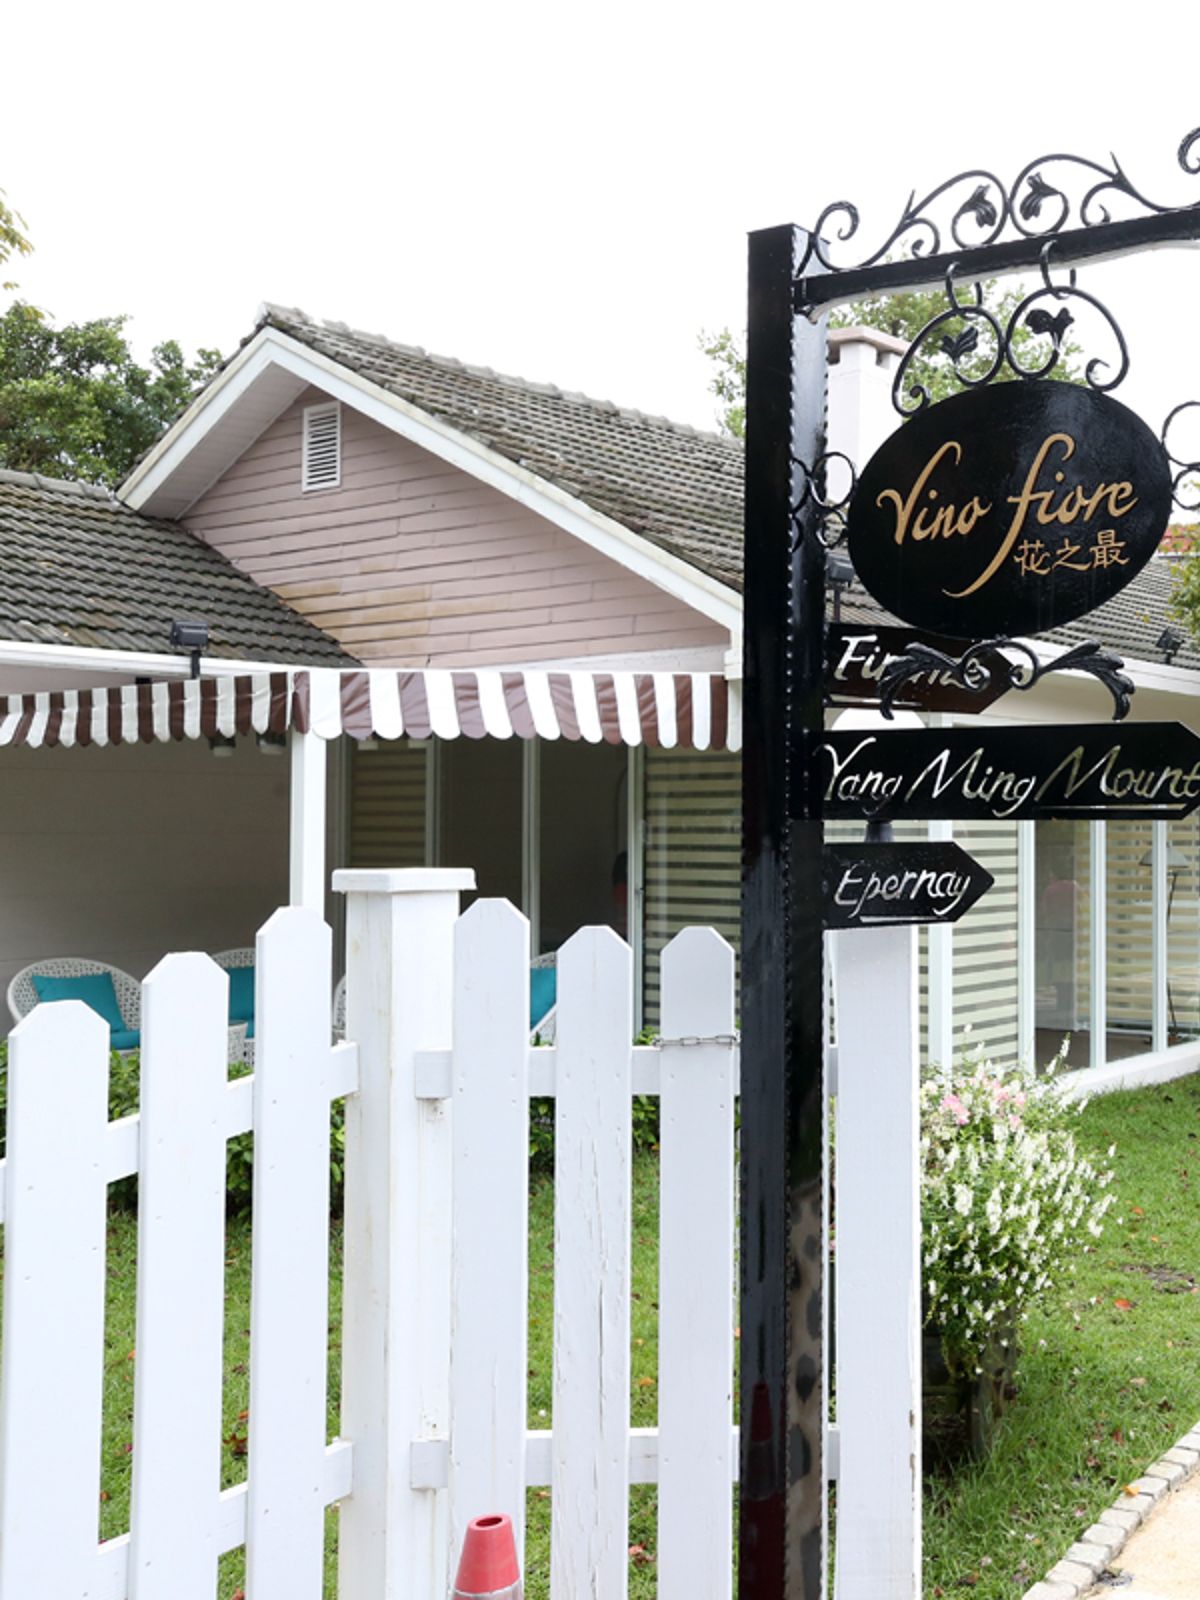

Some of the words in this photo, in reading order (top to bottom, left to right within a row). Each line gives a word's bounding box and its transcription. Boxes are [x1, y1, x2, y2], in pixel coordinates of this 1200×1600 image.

[877, 441, 992, 545] Vino
[942, 433, 1139, 598] fiore
[1013, 530, 1130, 577] 花之最
[823, 736, 903, 815] Yang
[904, 746, 1037, 817] Ming
